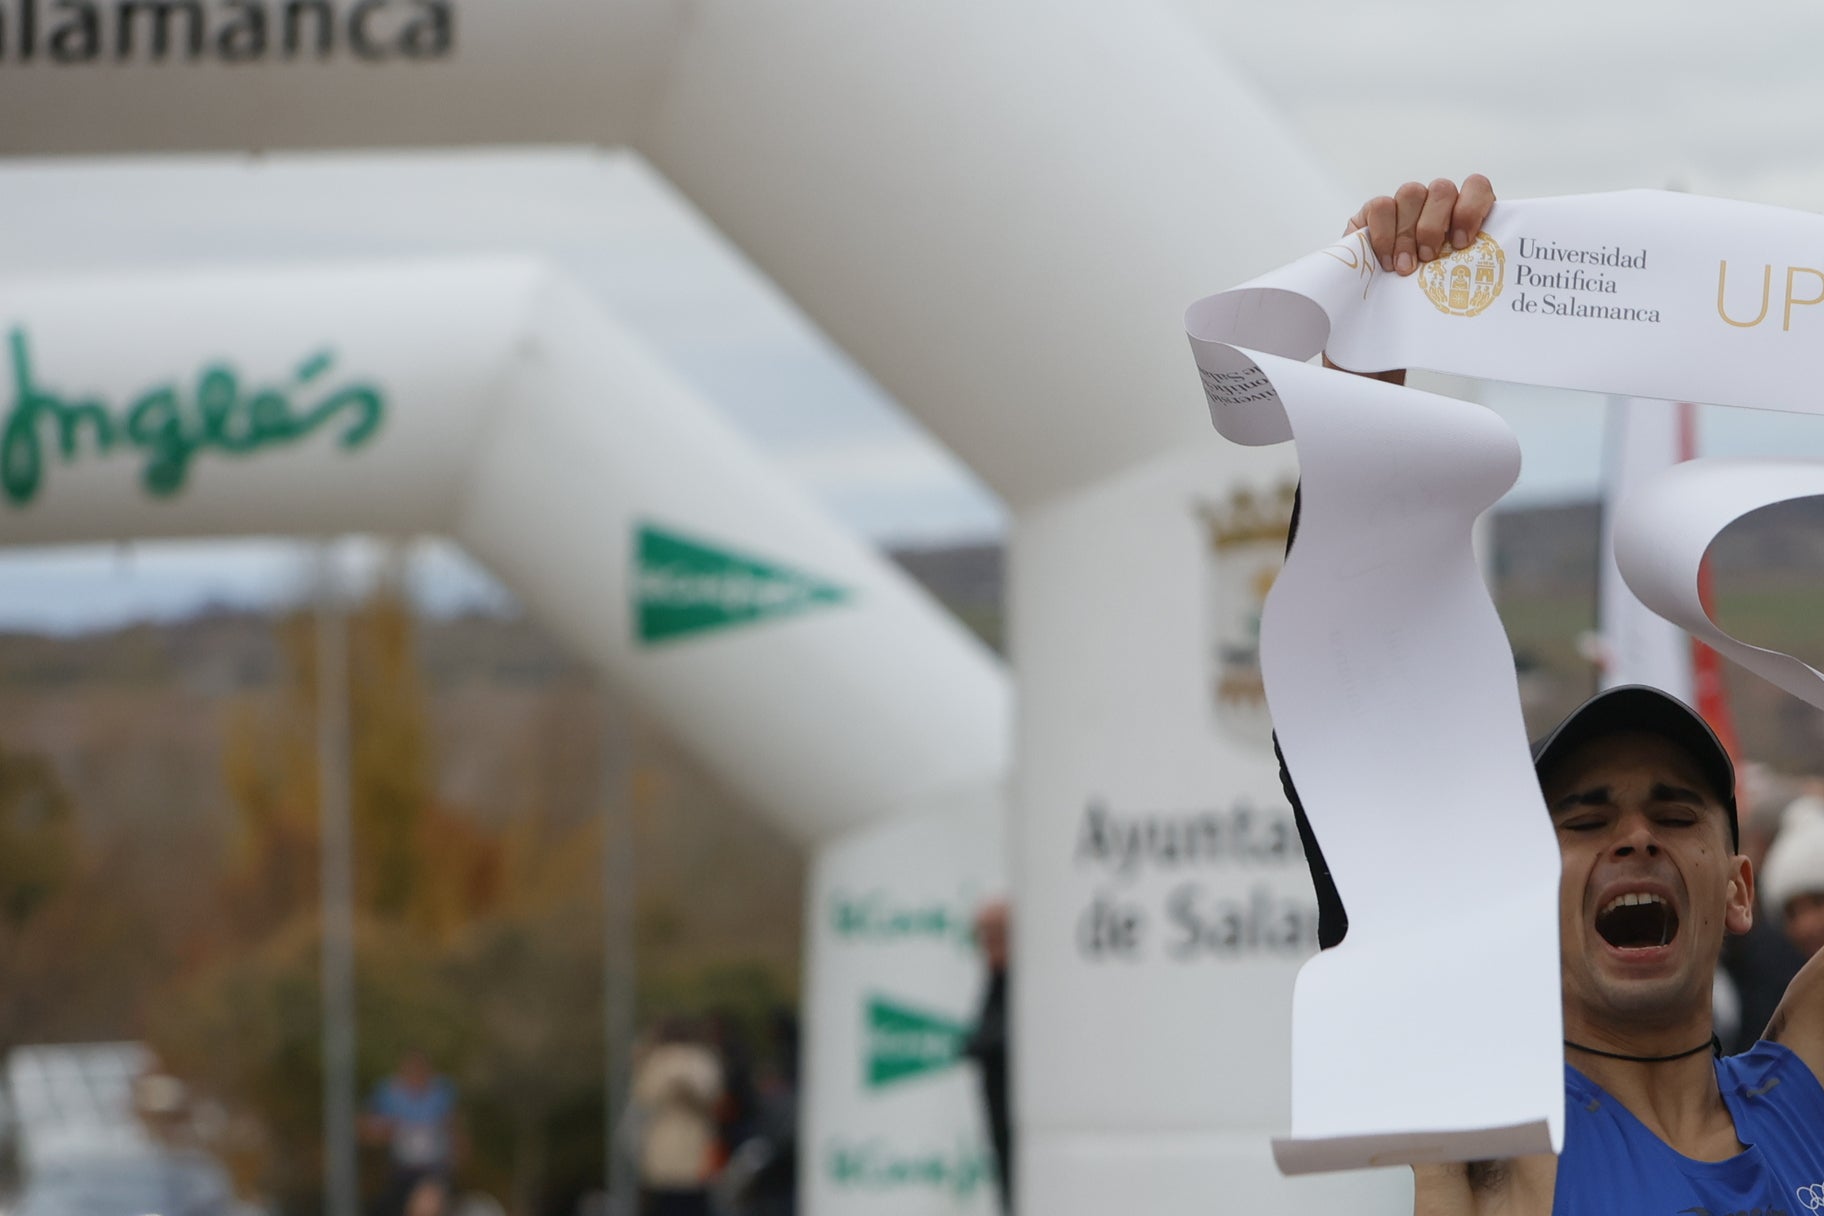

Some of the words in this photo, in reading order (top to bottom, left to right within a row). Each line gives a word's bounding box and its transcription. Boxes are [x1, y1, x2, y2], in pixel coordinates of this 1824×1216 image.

[0, 0, 457, 63] lamanca
[1519, 237, 1648, 270] Universidad
[1515, 264, 1618, 294] Pontificia
[1511, 293, 1538, 313] de
[1541, 294, 1661, 323] Salamanca
[1076, 796, 1304, 882] Ayunta
[1077, 888, 1150, 962] de
[1165, 881, 1318, 962] Sala
